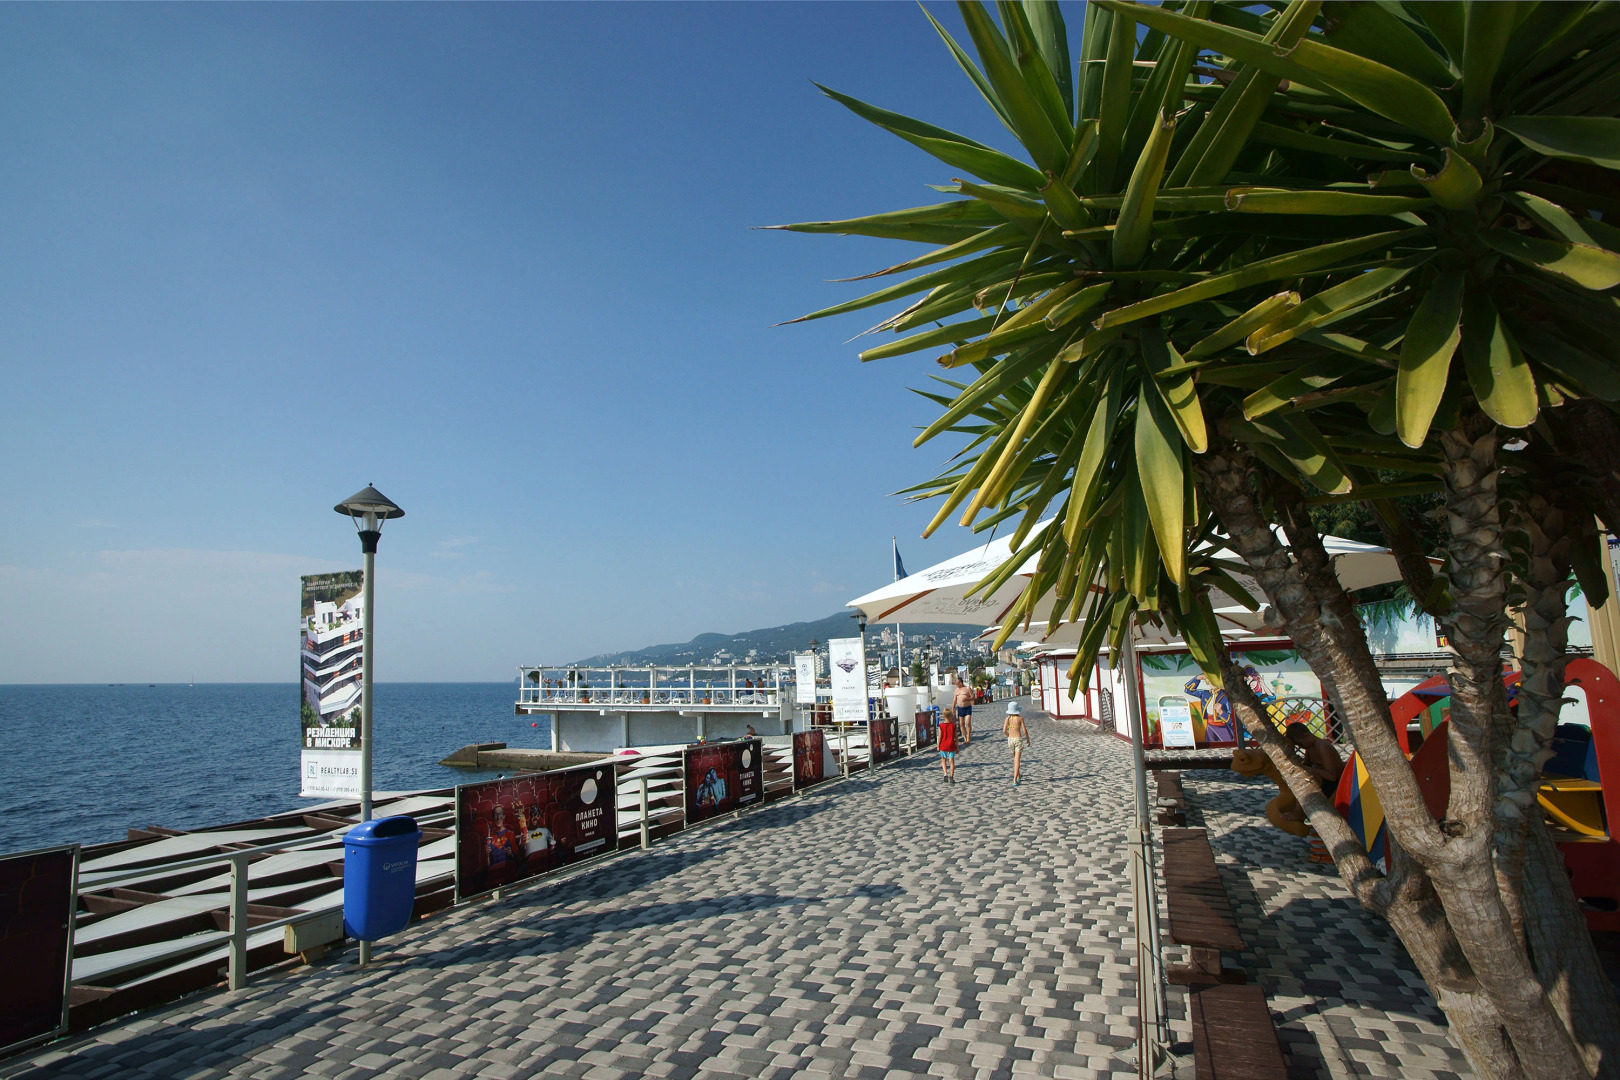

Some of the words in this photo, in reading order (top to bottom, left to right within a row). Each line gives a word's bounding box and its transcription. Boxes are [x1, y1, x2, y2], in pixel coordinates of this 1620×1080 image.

[306, 727, 356, 738] РЕЗИДЕНЦИЯ
[306, 737, 312, 748] В
[314, 737, 352, 748] МИСХОРЕ
[320, 767, 358, 775] REALTYLAB.SU
[575, 807, 603, 821] ПЛАНЕТА
[581, 818, 598, 830] КИНО
